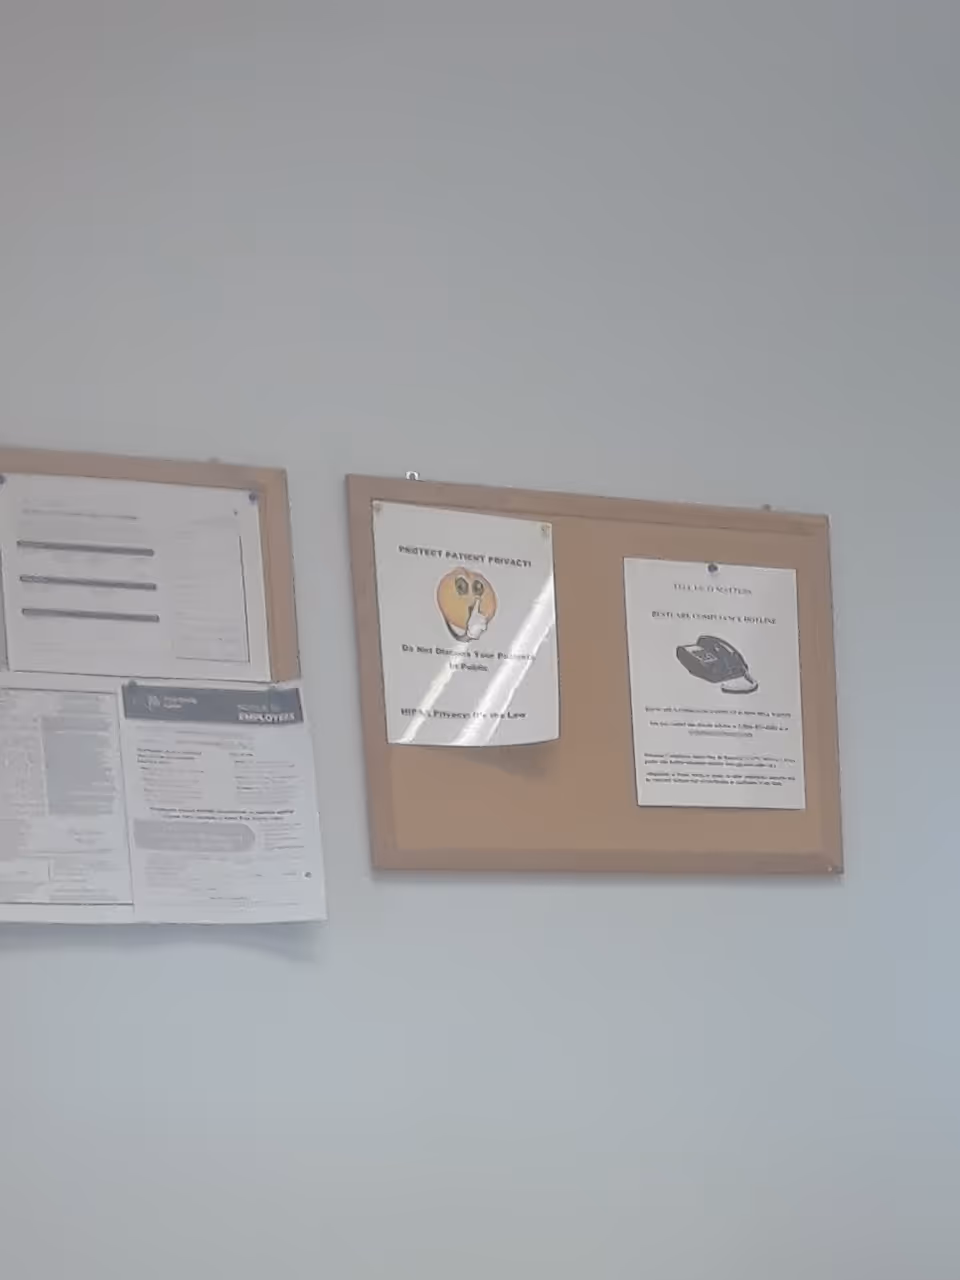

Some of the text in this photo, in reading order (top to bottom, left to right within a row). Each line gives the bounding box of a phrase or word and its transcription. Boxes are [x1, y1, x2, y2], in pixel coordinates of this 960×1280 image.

[398, 544, 443, 559] PROTECT
[445, 550, 485, 563] PATIENT
[743, 615, 777, 626] HOTLINE
[401, 643, 414, 653] Do
[416, 645, 433, 655] Not
[435, 647, 471, 658] Discs
[497, 651, 537, 662] Paents
[238, 711, 296, 723] EMPLOYEES
[400, 707, 432, 718] HIP
[507, 710, 527, 720] Law
